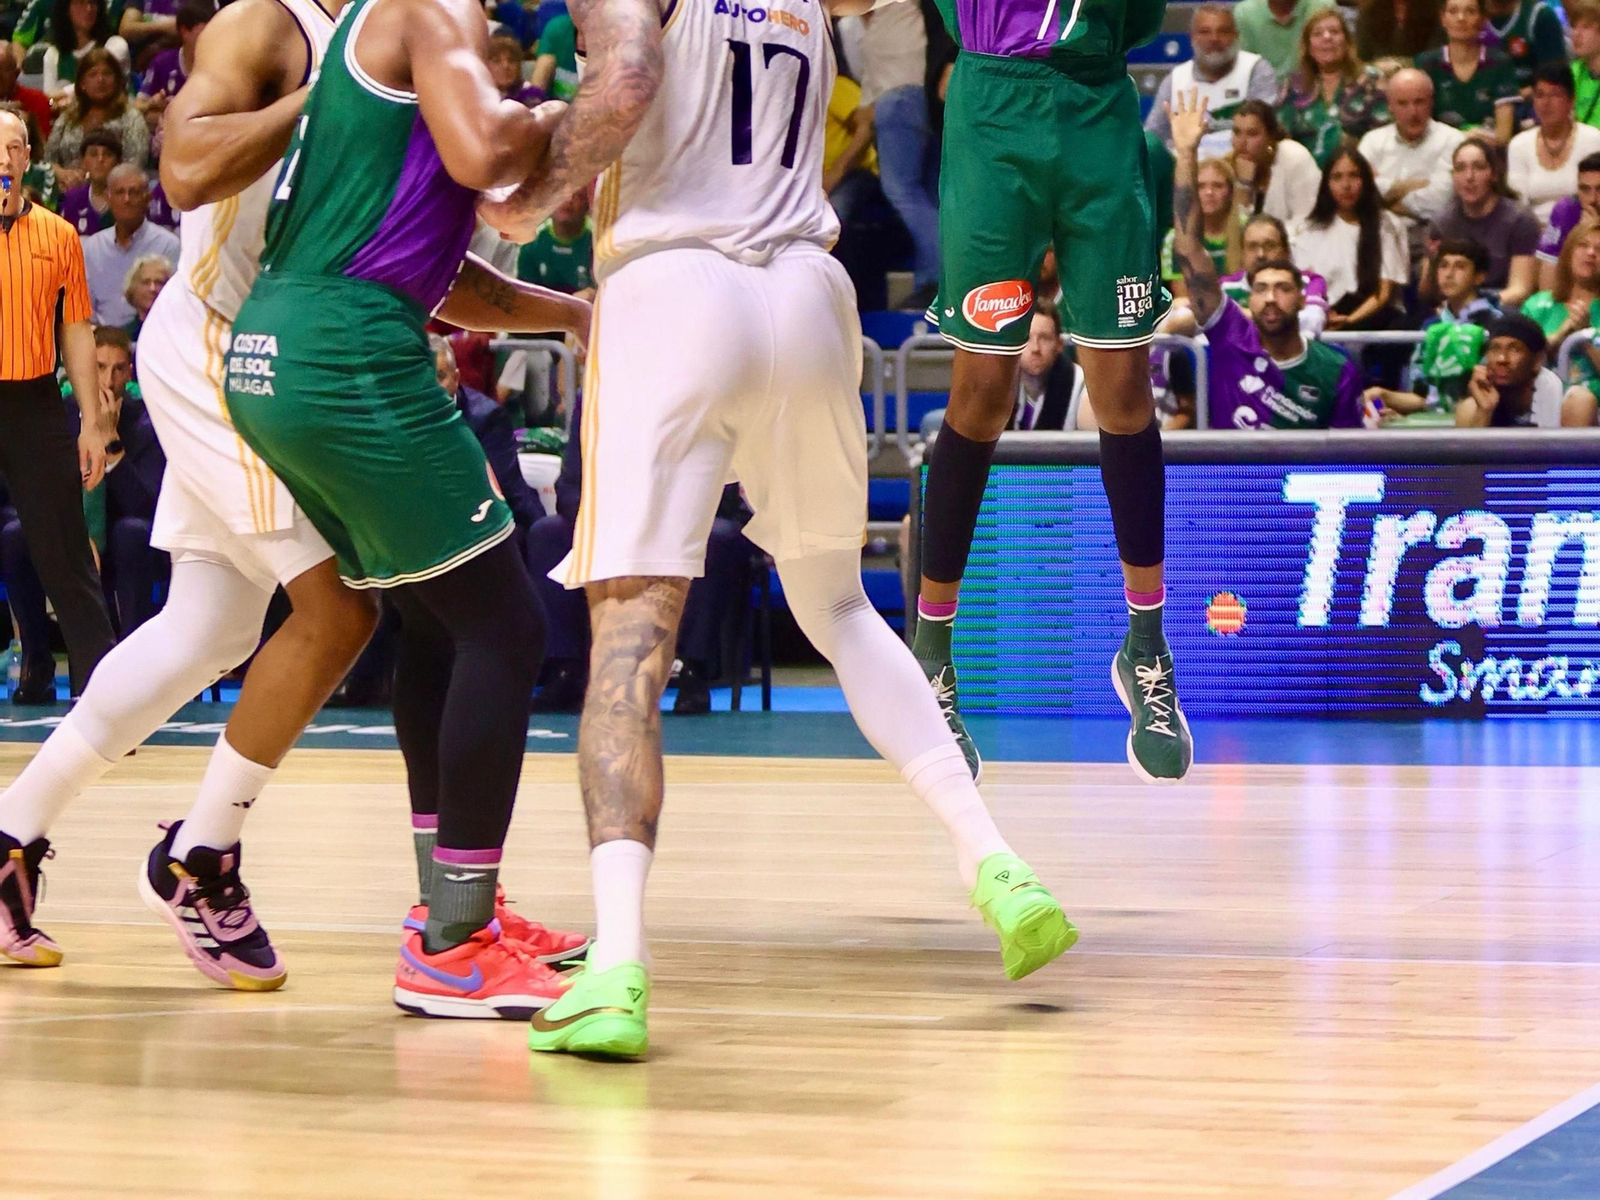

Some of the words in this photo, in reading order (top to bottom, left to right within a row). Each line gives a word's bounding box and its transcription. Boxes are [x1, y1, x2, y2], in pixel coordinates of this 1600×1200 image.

[725, 38, 811, 170] 17
[1116, 275, 1138, 285] sabor
[1283, 472, 1600, 629] Tran
